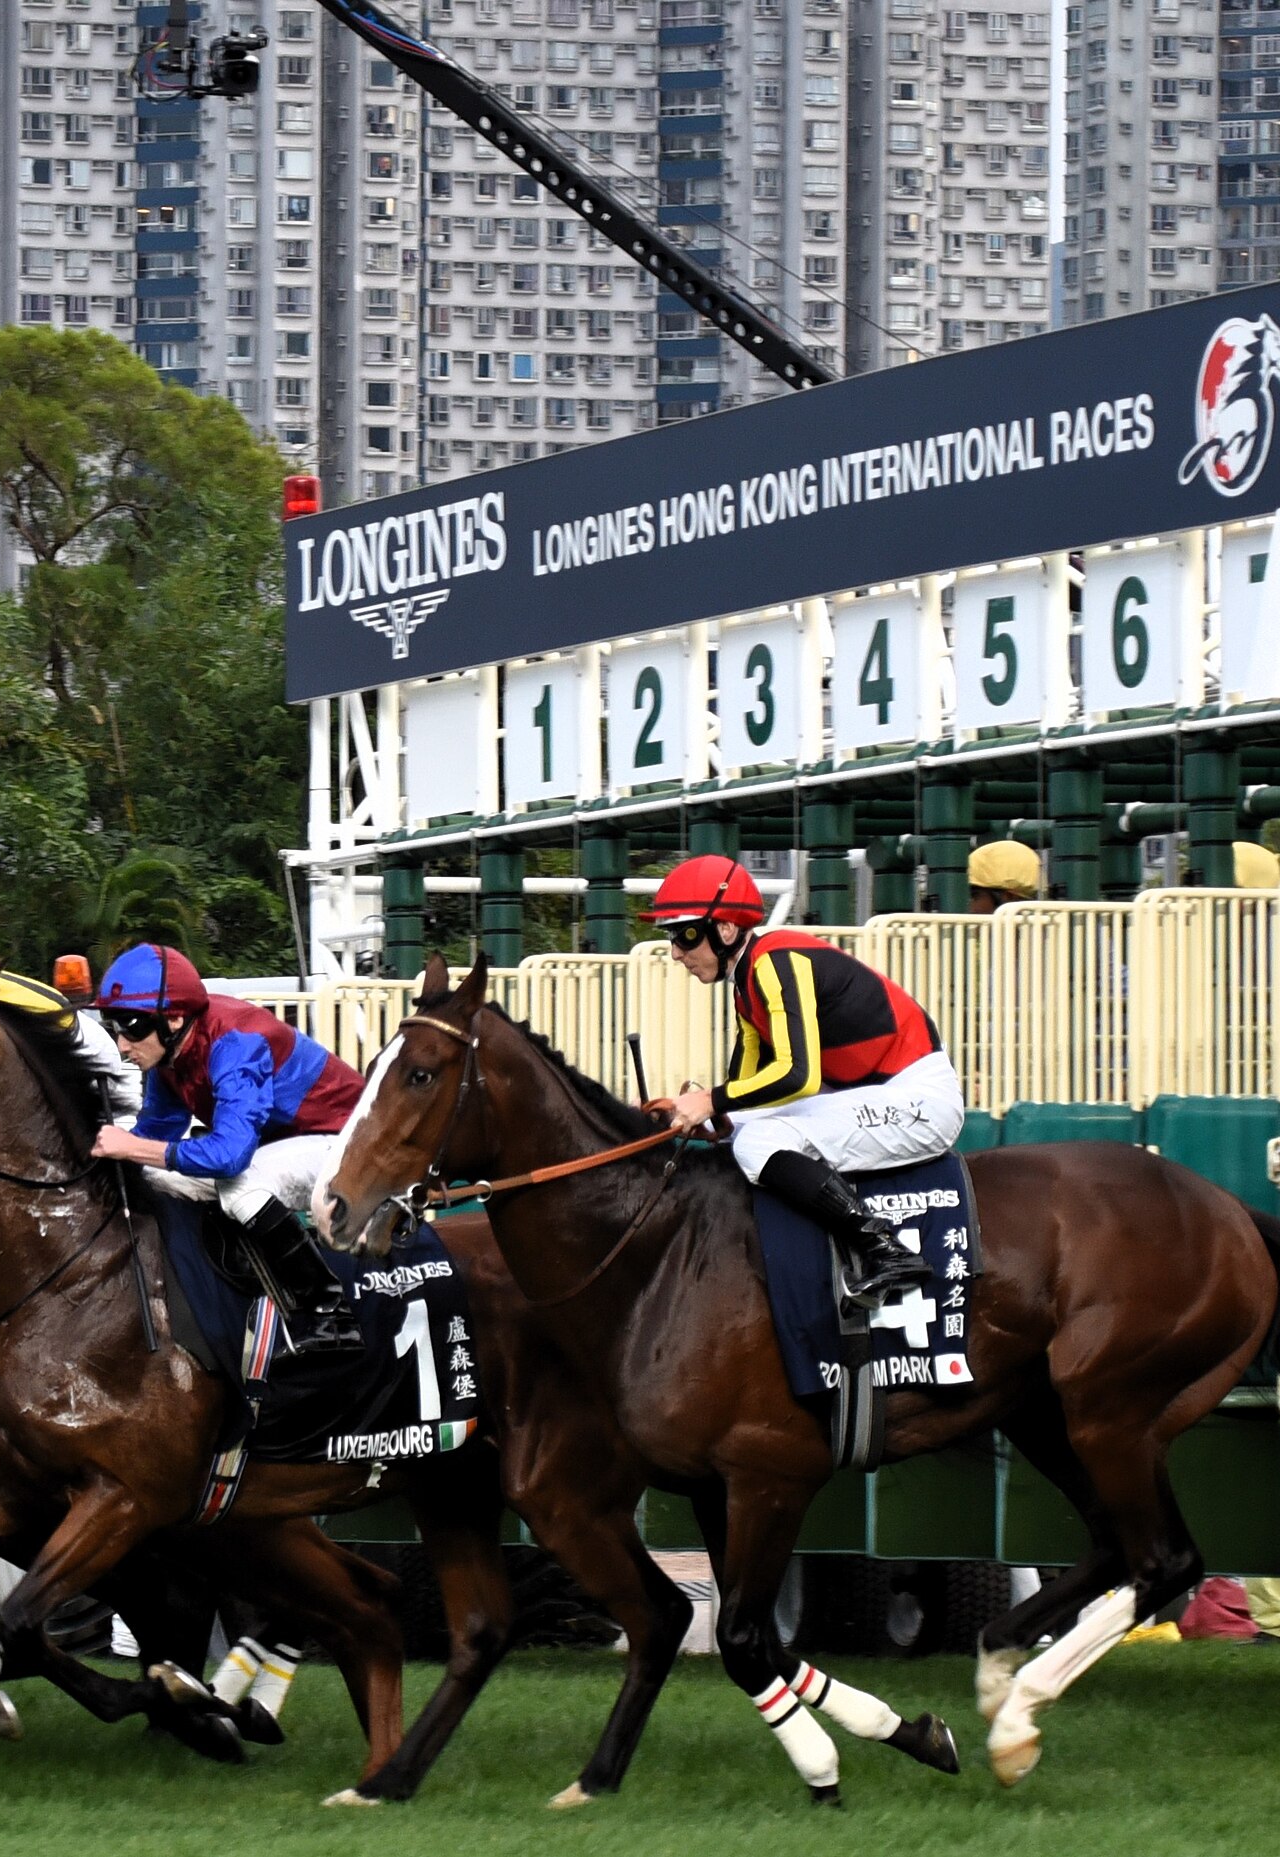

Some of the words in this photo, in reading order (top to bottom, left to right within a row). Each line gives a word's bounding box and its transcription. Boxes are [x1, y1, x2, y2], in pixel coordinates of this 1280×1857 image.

[533, 502, 655, 576] LONGINES
[659, 483, 736, 548] HONG
[740, 463, 818, 529] KONG
[822, 417, 1045, 509] INTERNATIONAL
[1050, 393, 1155, 465] RACES
[297, 491, 507, 612] LONGINES
[859, 618, 894, 726] 4
[982, 596, 1017, 707] 5
[1112, 576, 1149, 689] 6
[533, 683, 552, 783] 1
[633, 666, 663, 769] 2
[744, 643, 775, 747] 3
[864, 1189, 960, 1212] NGINES
[942, 1226, 971, 1339] 利森名園
[394, 1298, 441, 1421] 1
[446, 1315, 477, 1401] 盧森堡
[889, 1355, 934, 1385] PARK
[326, 1424, 433, 1461] LUXEMBOURG
